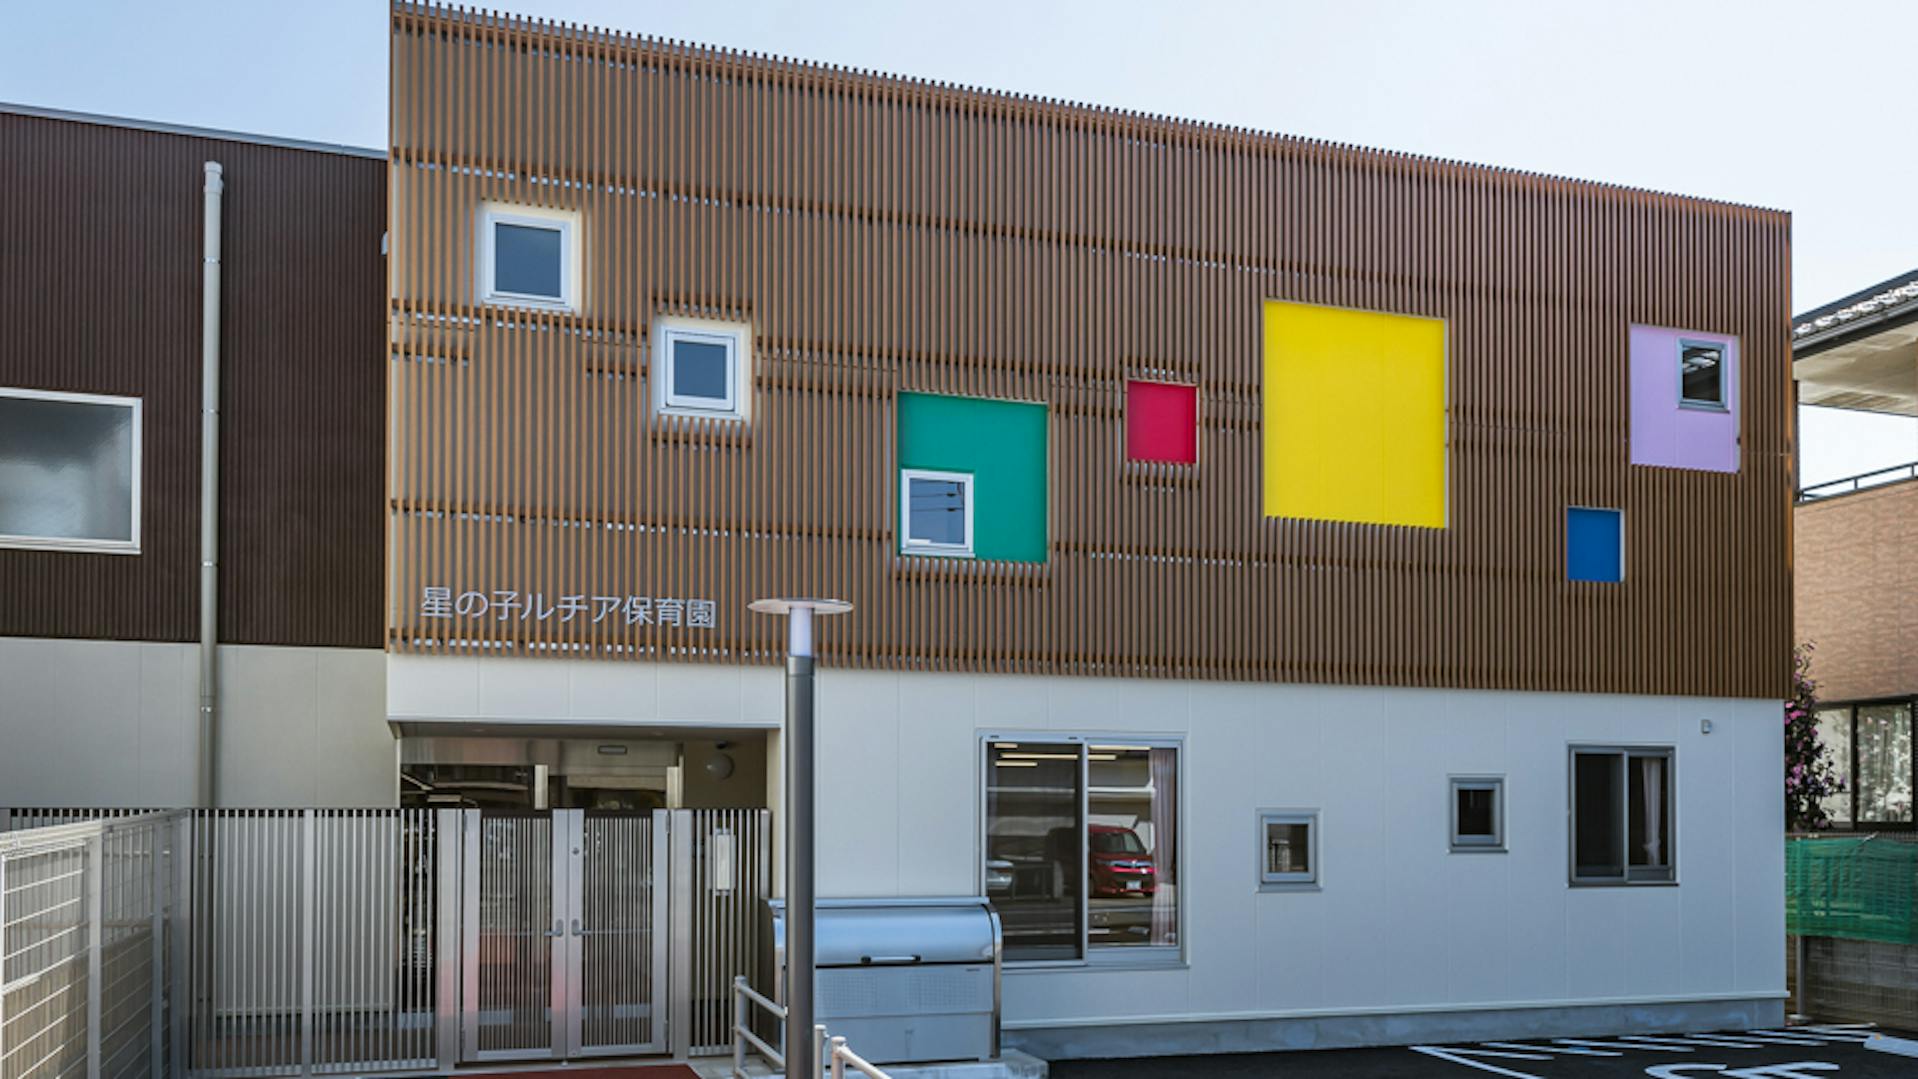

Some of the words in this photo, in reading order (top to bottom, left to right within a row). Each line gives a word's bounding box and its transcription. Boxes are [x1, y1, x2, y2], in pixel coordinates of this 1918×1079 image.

[420, 586, 716, 629] 星の子ルチア保育園
